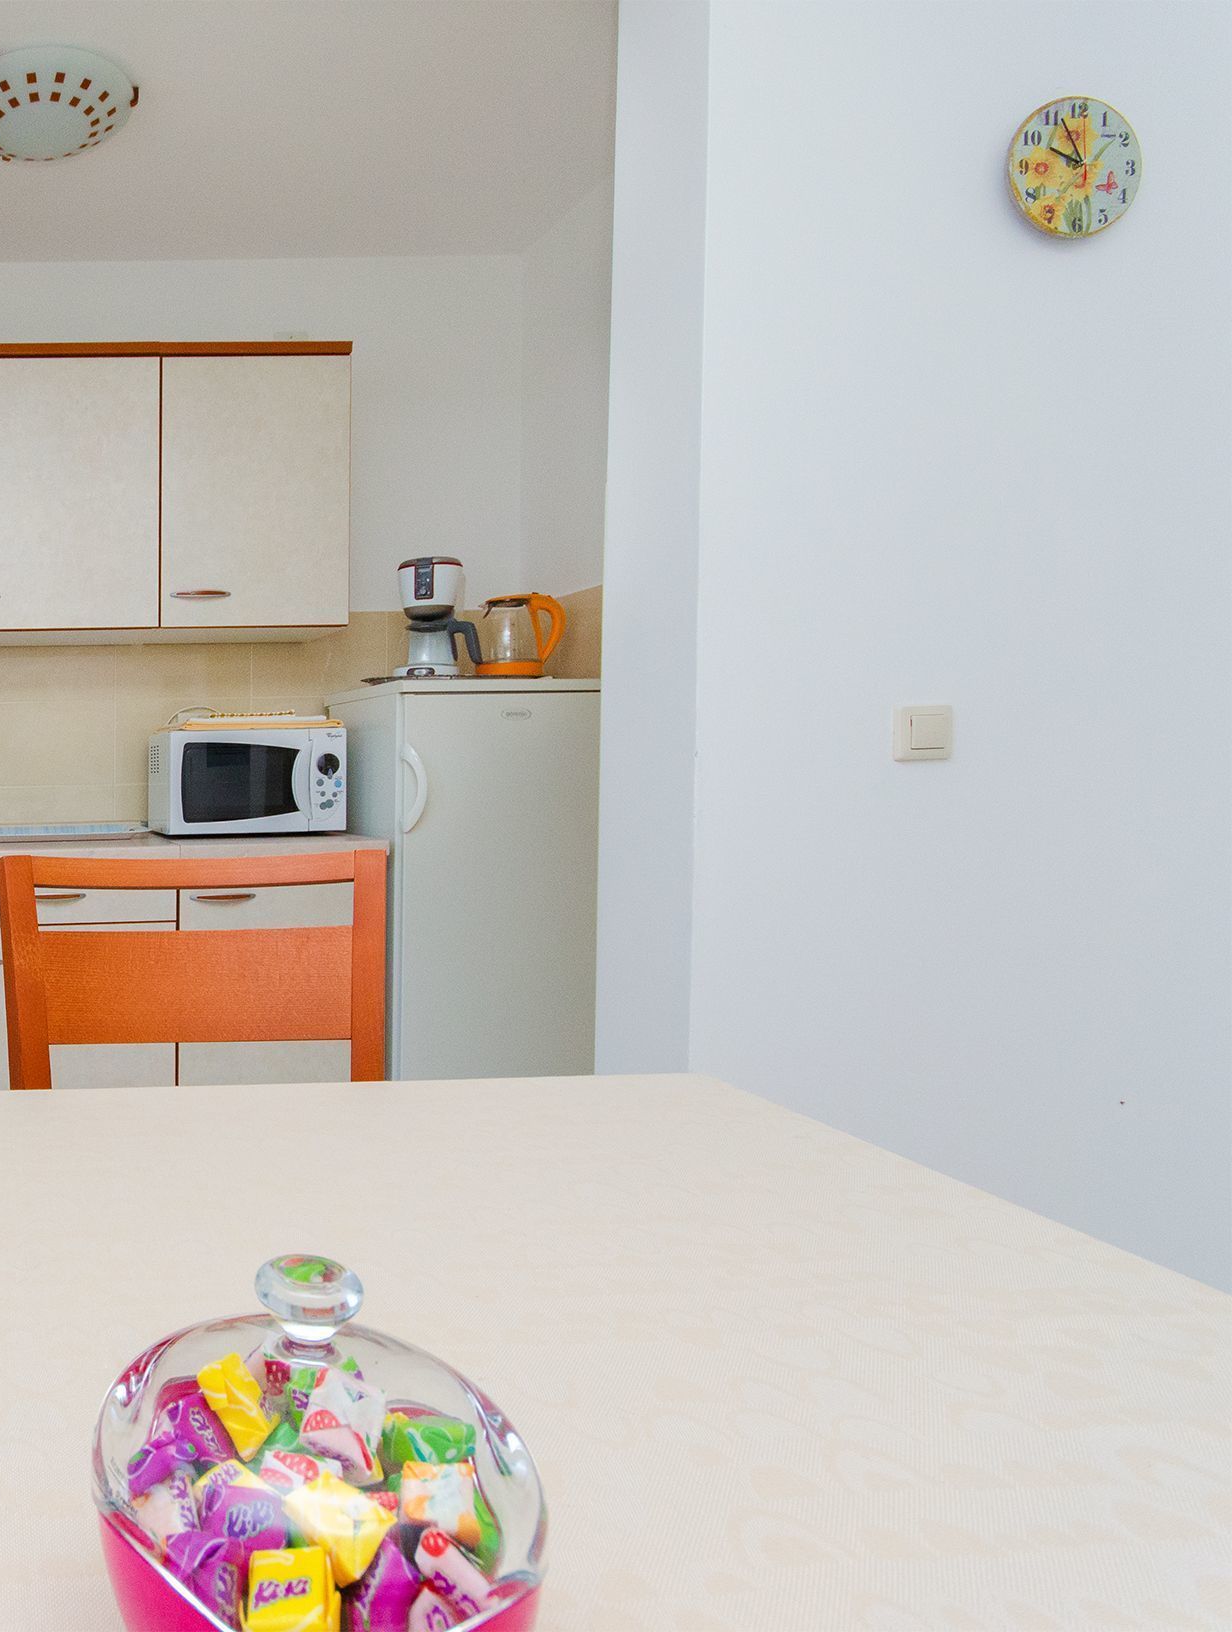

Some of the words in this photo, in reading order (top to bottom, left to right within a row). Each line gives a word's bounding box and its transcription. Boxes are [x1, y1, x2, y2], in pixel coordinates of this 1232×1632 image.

[1043, 110, 1059, 126] 11
[1070, 102, 1089, 119] 12
[1101, 111, 1109, 127] 1
[1023, 130, 1042, 147] 10
[1118, 131, 1130, 148] 2
[1019, 159, 1029, 176] 9
[1125, 159, 1136, 176] 3
[1025, 186, 1037, 204] 8
[1118, 188, 1127, 204] 4
[1071, 217, 1083, 233] 6
[1097, 208, 1109, 225] 5
